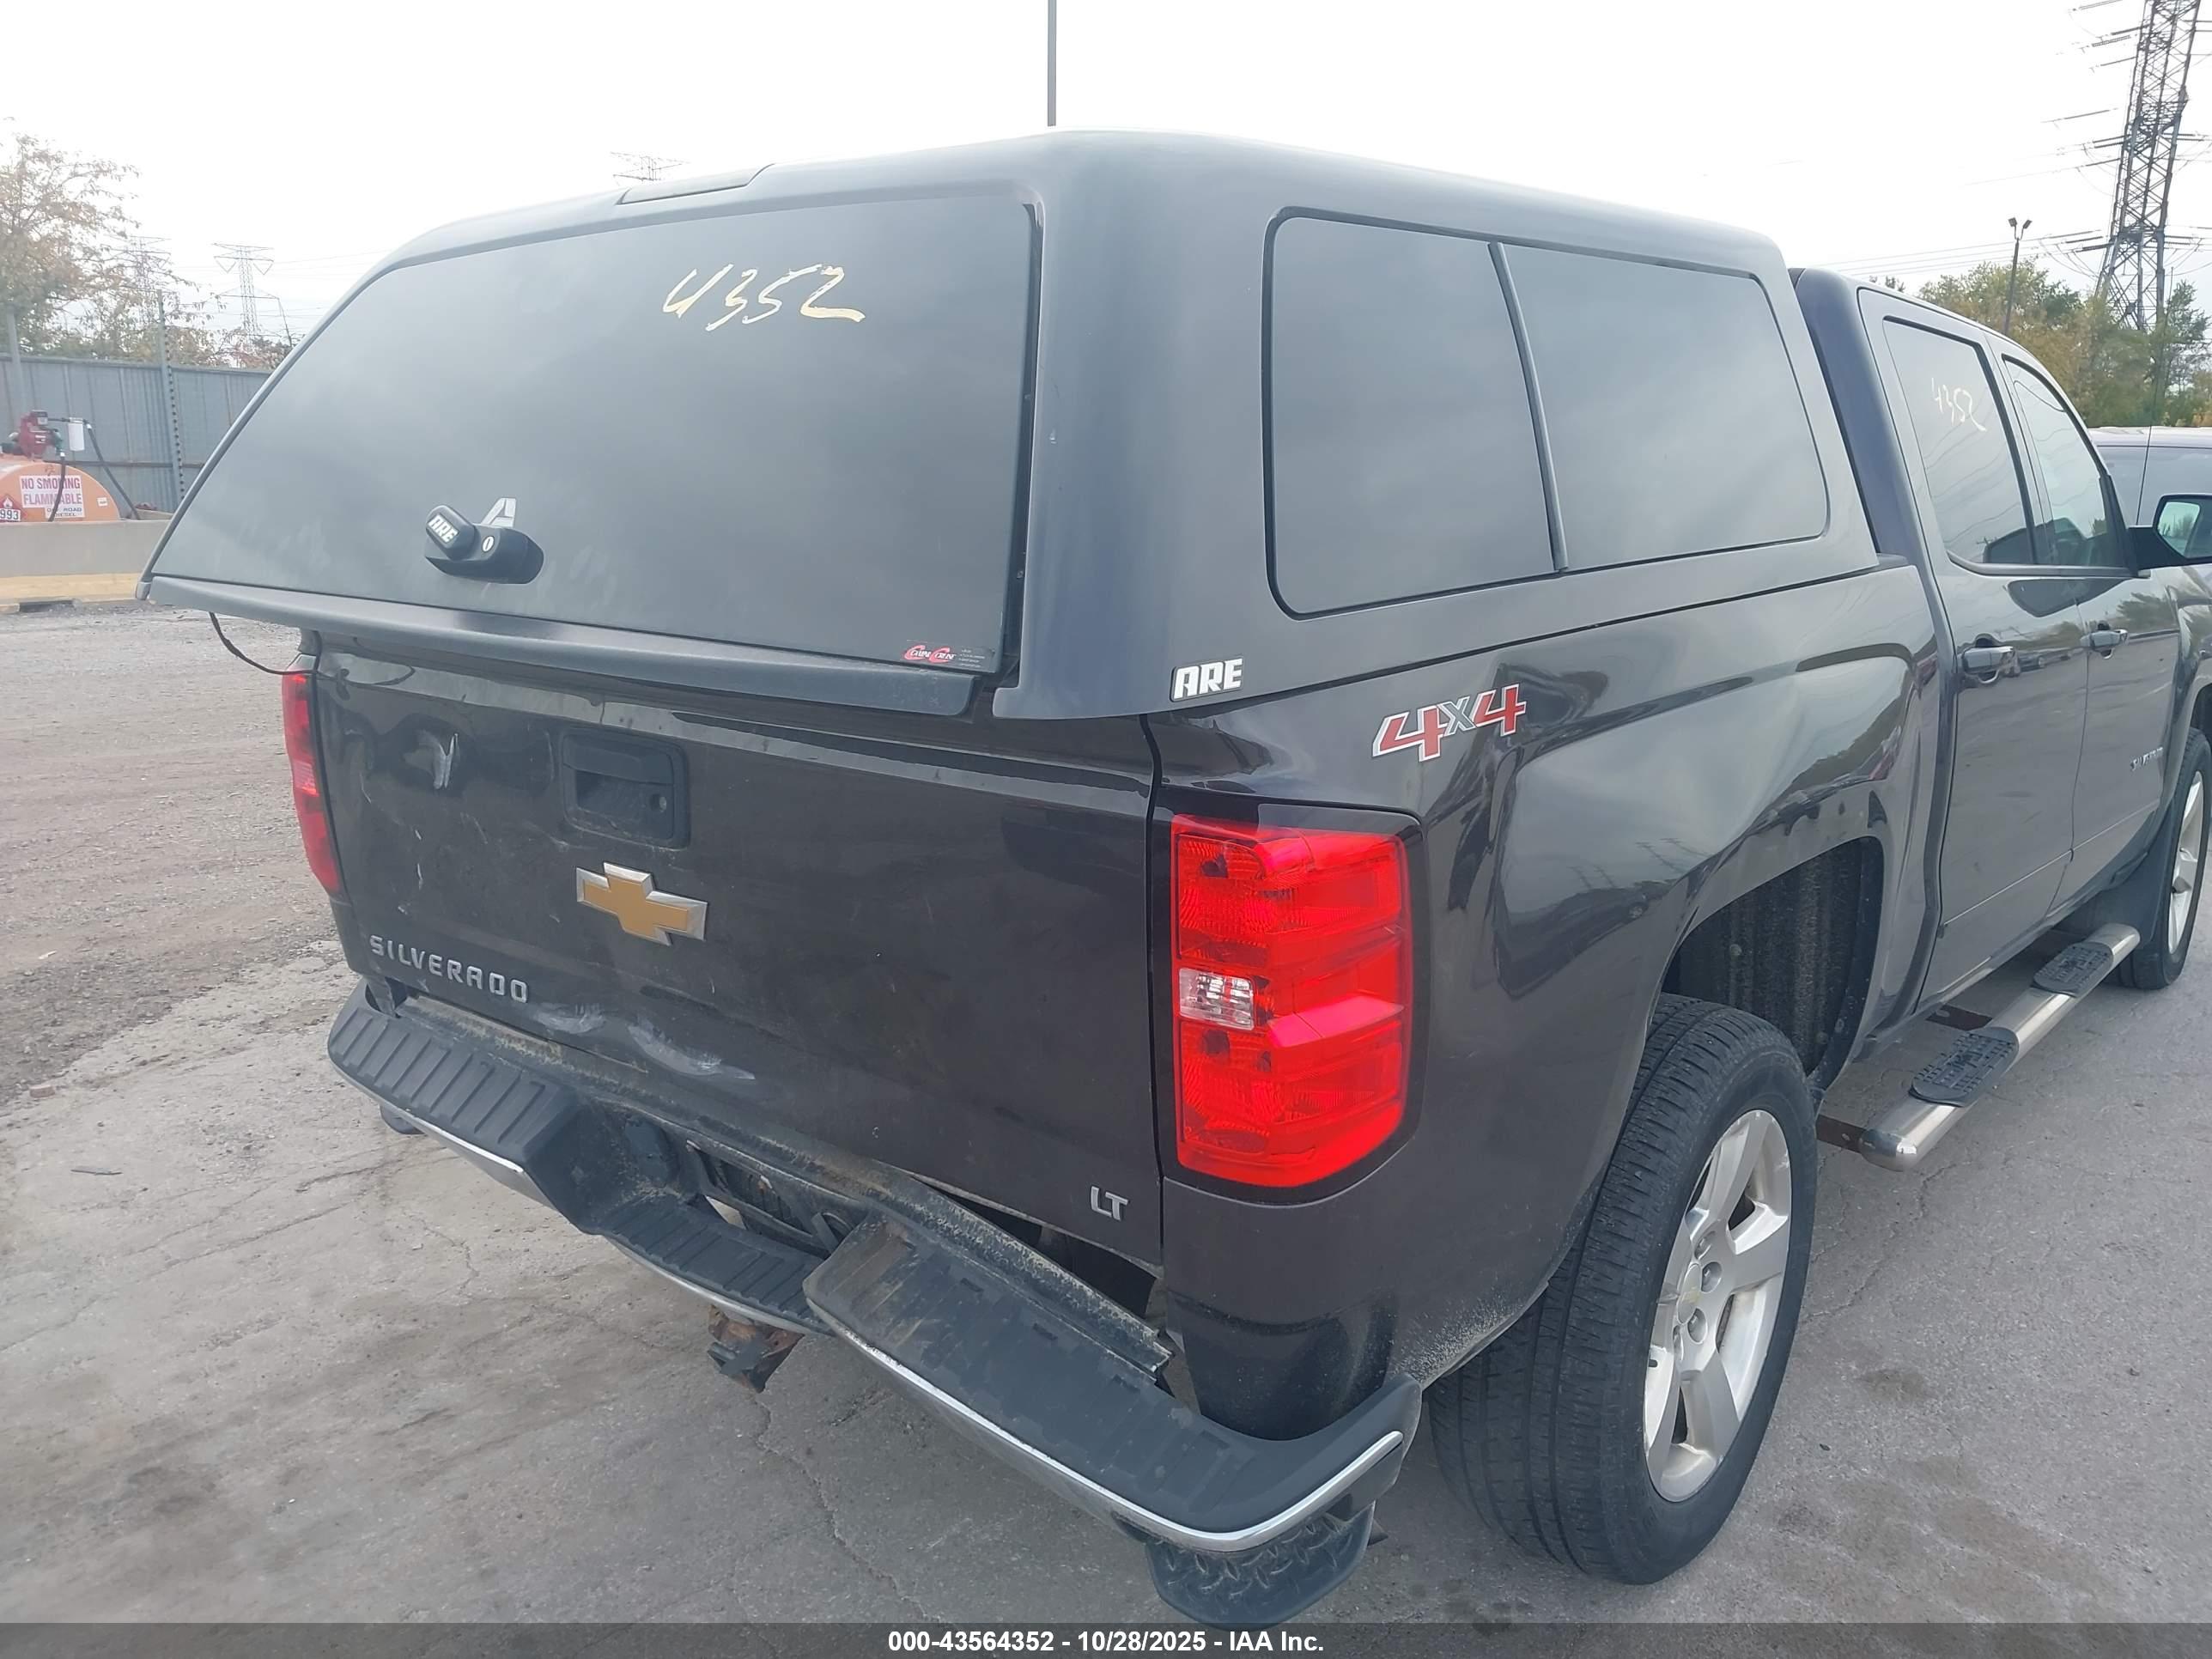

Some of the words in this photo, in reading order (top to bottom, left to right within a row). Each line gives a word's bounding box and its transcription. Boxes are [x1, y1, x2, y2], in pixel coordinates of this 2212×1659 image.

[21, 477, 34, 489] NO
[428, 513, 459, 543] ARE
[1173, 658, 1243, 699] ARE
[369, 934, 529, 1004] SILVERADO
[1091, 1186, 1128, 1221] LT
